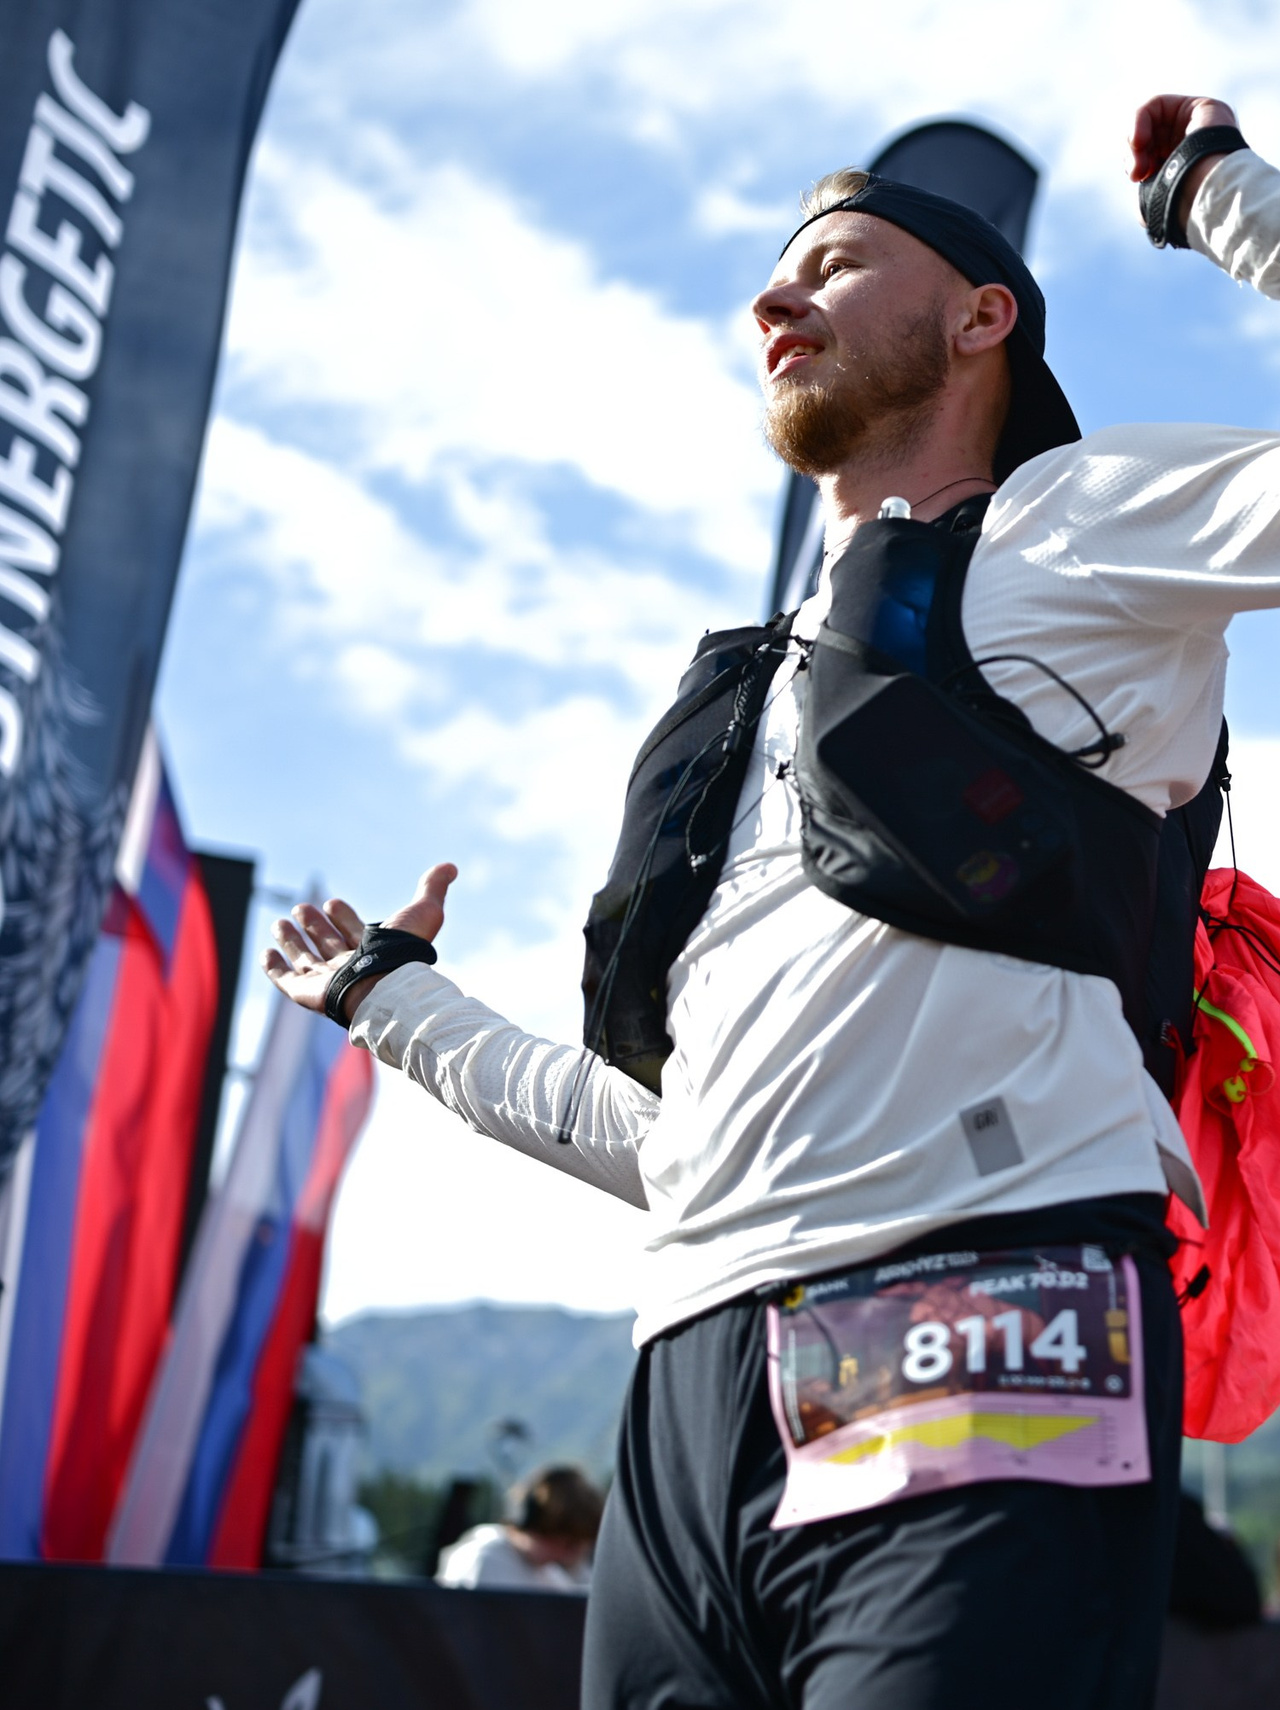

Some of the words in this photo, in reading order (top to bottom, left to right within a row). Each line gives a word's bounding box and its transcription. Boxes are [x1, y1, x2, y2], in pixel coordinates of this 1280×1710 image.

[0, 28, 151, 776] NERGETIC
[969, 1274, 1025, 1296] PEAK
[901, 1308, 1087, 1384] 8114
